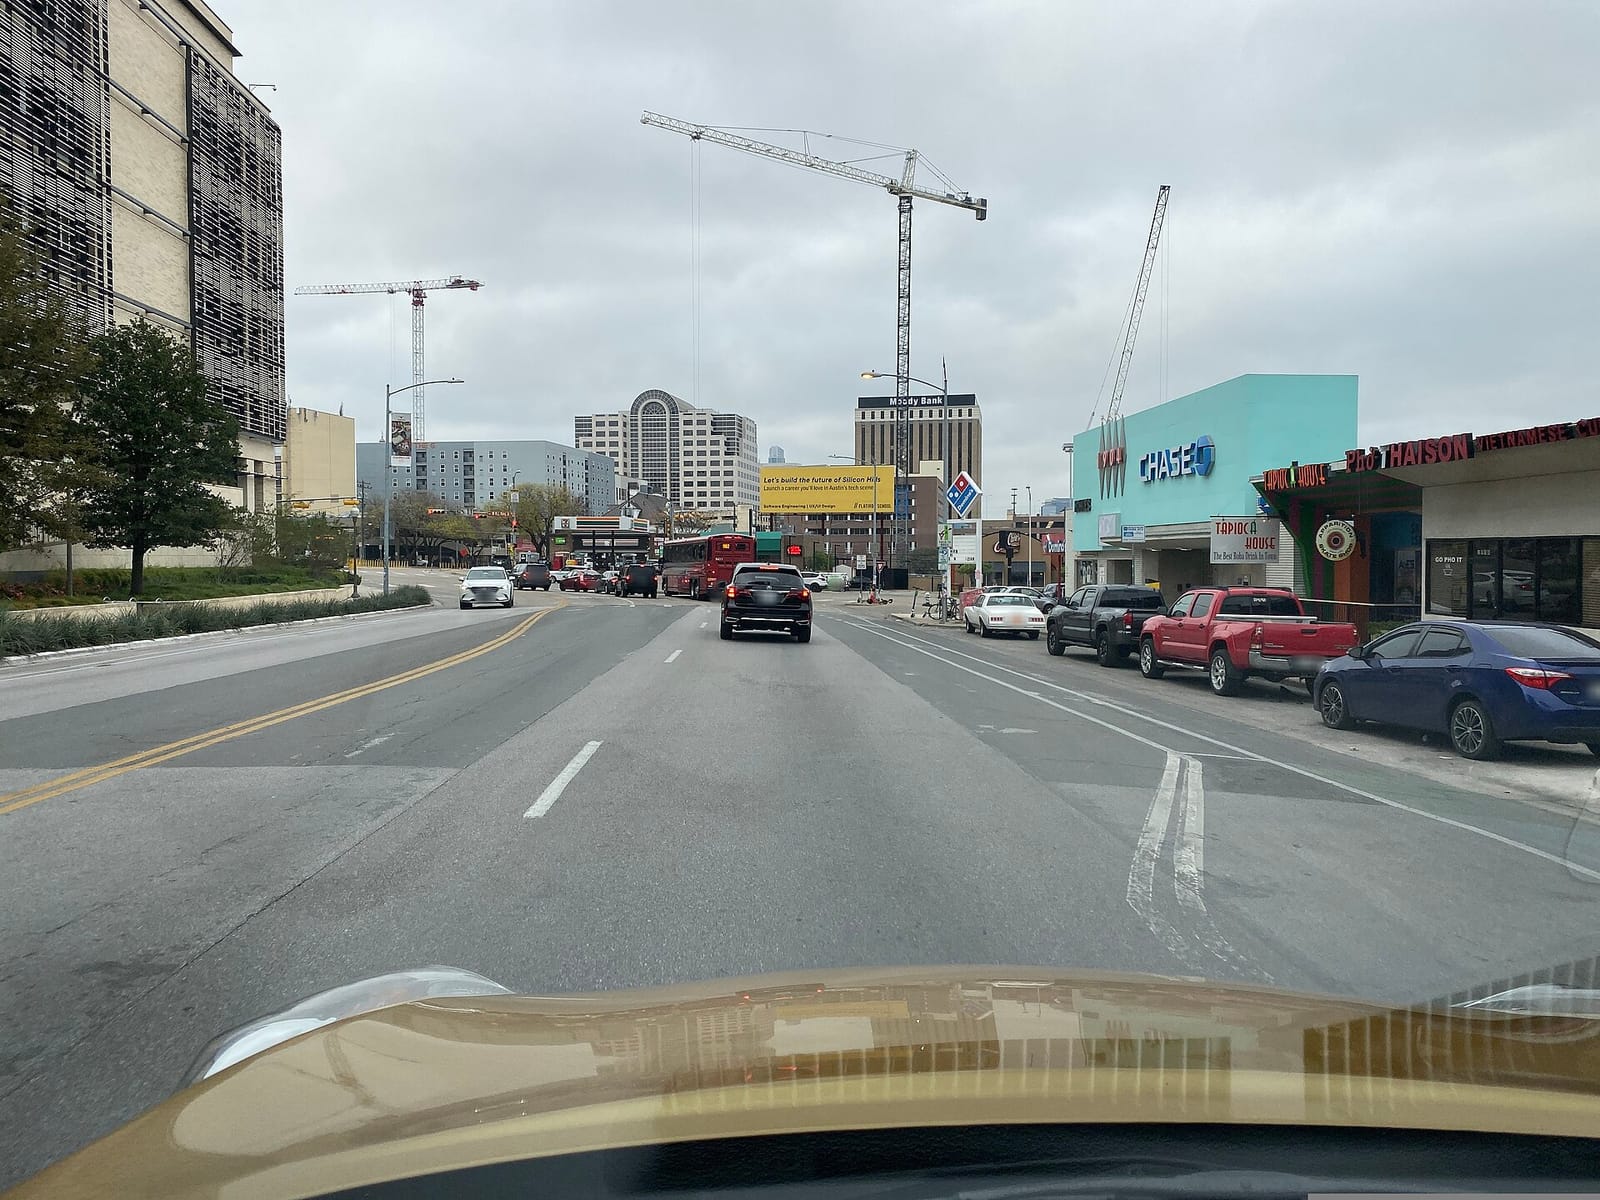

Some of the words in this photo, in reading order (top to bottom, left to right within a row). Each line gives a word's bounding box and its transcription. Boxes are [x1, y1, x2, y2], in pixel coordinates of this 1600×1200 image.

[889, 397, 919, 406] Moody
[920, 396, 943, 405] Bank
[1475, 424, 1568, 451] VIETNAMESE
[1138, 443, 1195, 483] CHASE
[1298, 463, 1327, 489] HOUSE
[1215, 521, 1257, 535] TAPIOCA
[1244, 537, 1276, 550] HOUSE
[1213, 552, 1222, 560] The
[1222, 552, 1233, 560] Best
